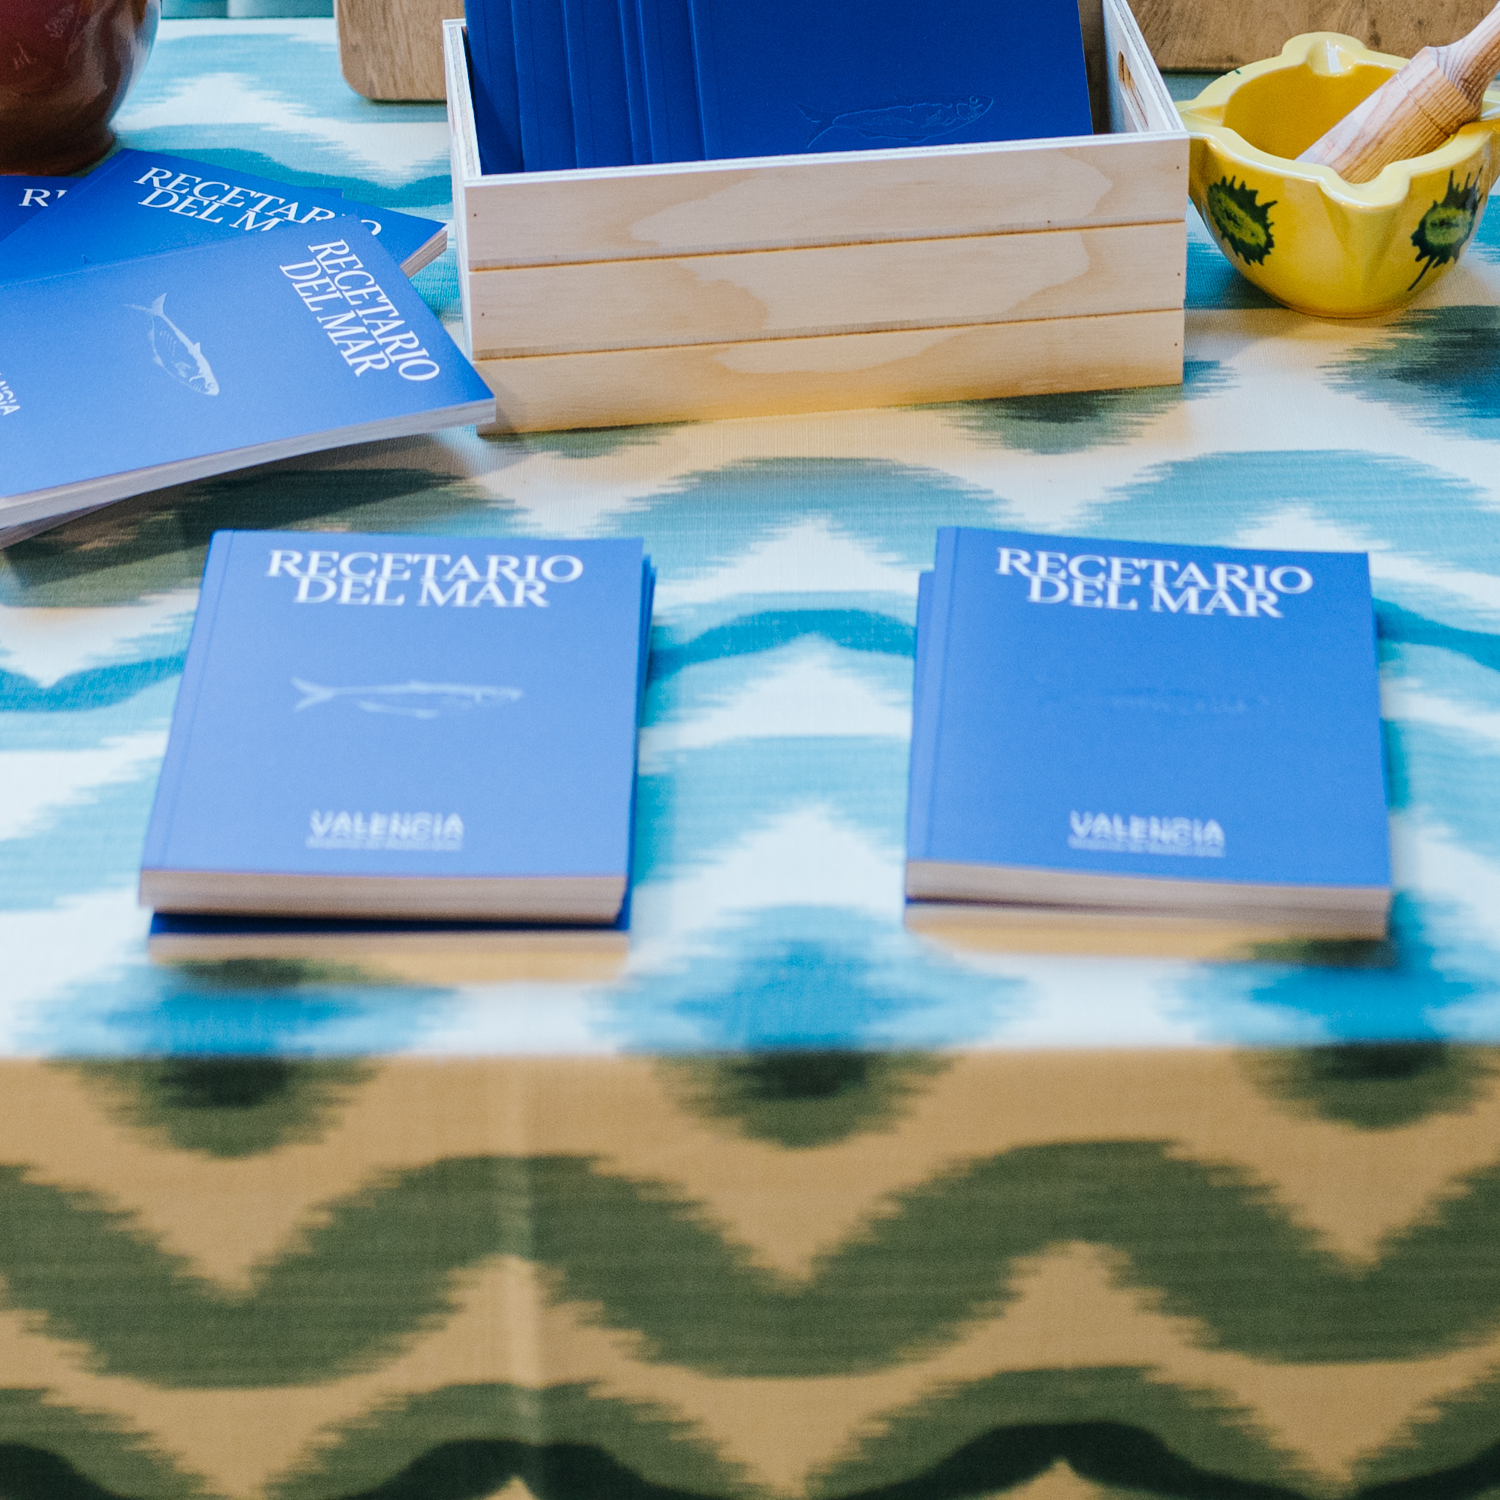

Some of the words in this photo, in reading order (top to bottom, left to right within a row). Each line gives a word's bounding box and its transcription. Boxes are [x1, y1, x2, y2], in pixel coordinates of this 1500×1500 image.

[134, 167, 382, 236] RECETAR
[138, 188, 225, 224] DEL
[279, 259, 343, 312] DEL
[316, 310, 390, 377] MAR
[308, 239, 440, 381] RECETARIO
[265, 548, 584, 584] RECETARIO
[996, 547, 1314, 595] RECETARIO
[294, 576, 404, 606] DEL
[417, 579, 550, 608] MAR
[1027, 575, 1138, 611] DEL
[1150, 585, 1284, 619] MAR
[310, 809, 464, 840] VALENCIA
[1069, 810, 1226, 847] VALENCIA
